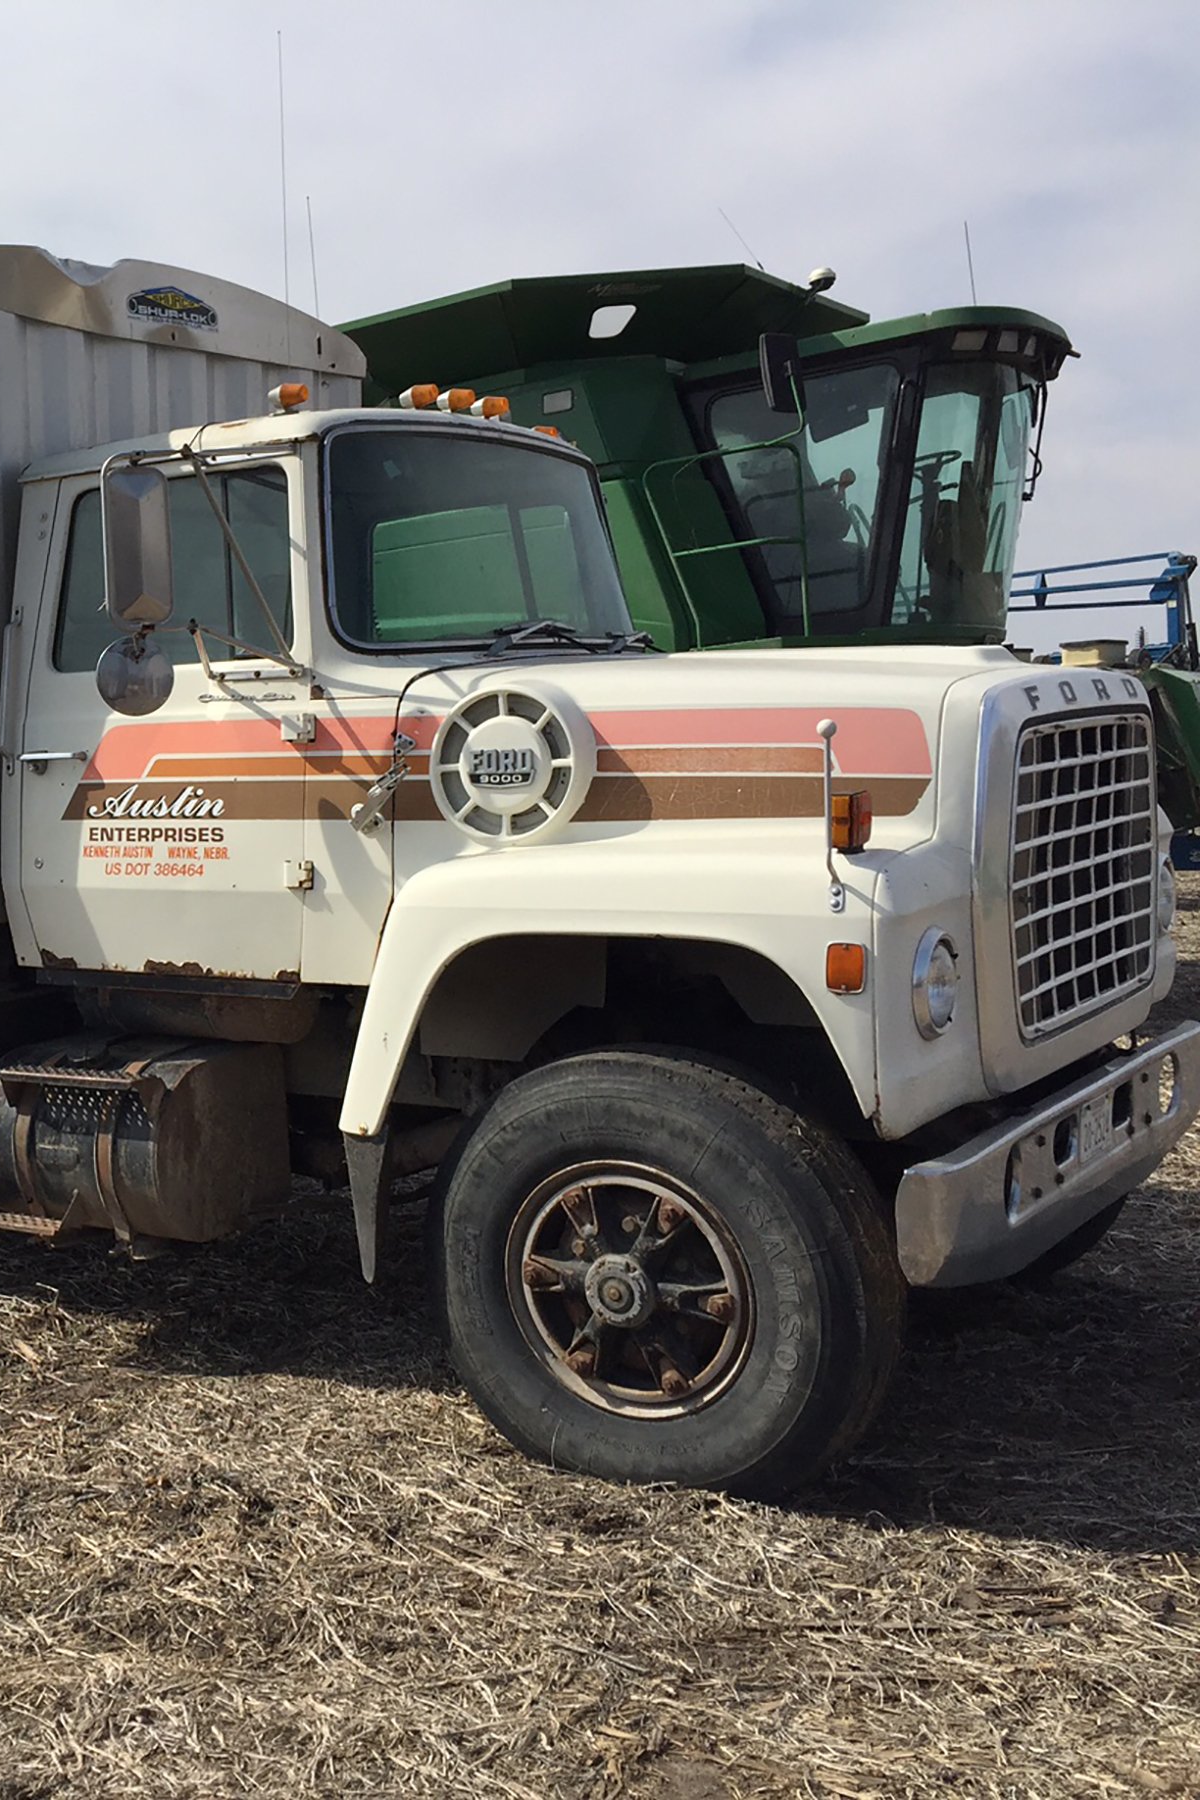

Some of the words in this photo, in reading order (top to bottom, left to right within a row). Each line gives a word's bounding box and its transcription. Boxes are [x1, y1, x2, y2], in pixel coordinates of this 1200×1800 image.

[1023, 678, 1138, 711] FORD
[469, 748, 535, 773] FORD
[479, 774, 523, 784] 9000
[88, 783, 225, 819] Austin
[89, 827, 224, 843] ENTERPRISES
[83, 845, 120, 858] KENNETH
[122, 846, 154, 859] AUSTIN
[168, 846, 201, 860] WAYNE,
[204, 847, 230, 860] NEBR.
[105, 863, 122, 875] US
[125, 863, 150, 876] DOT
[153, 863, 204, 877] 386464
